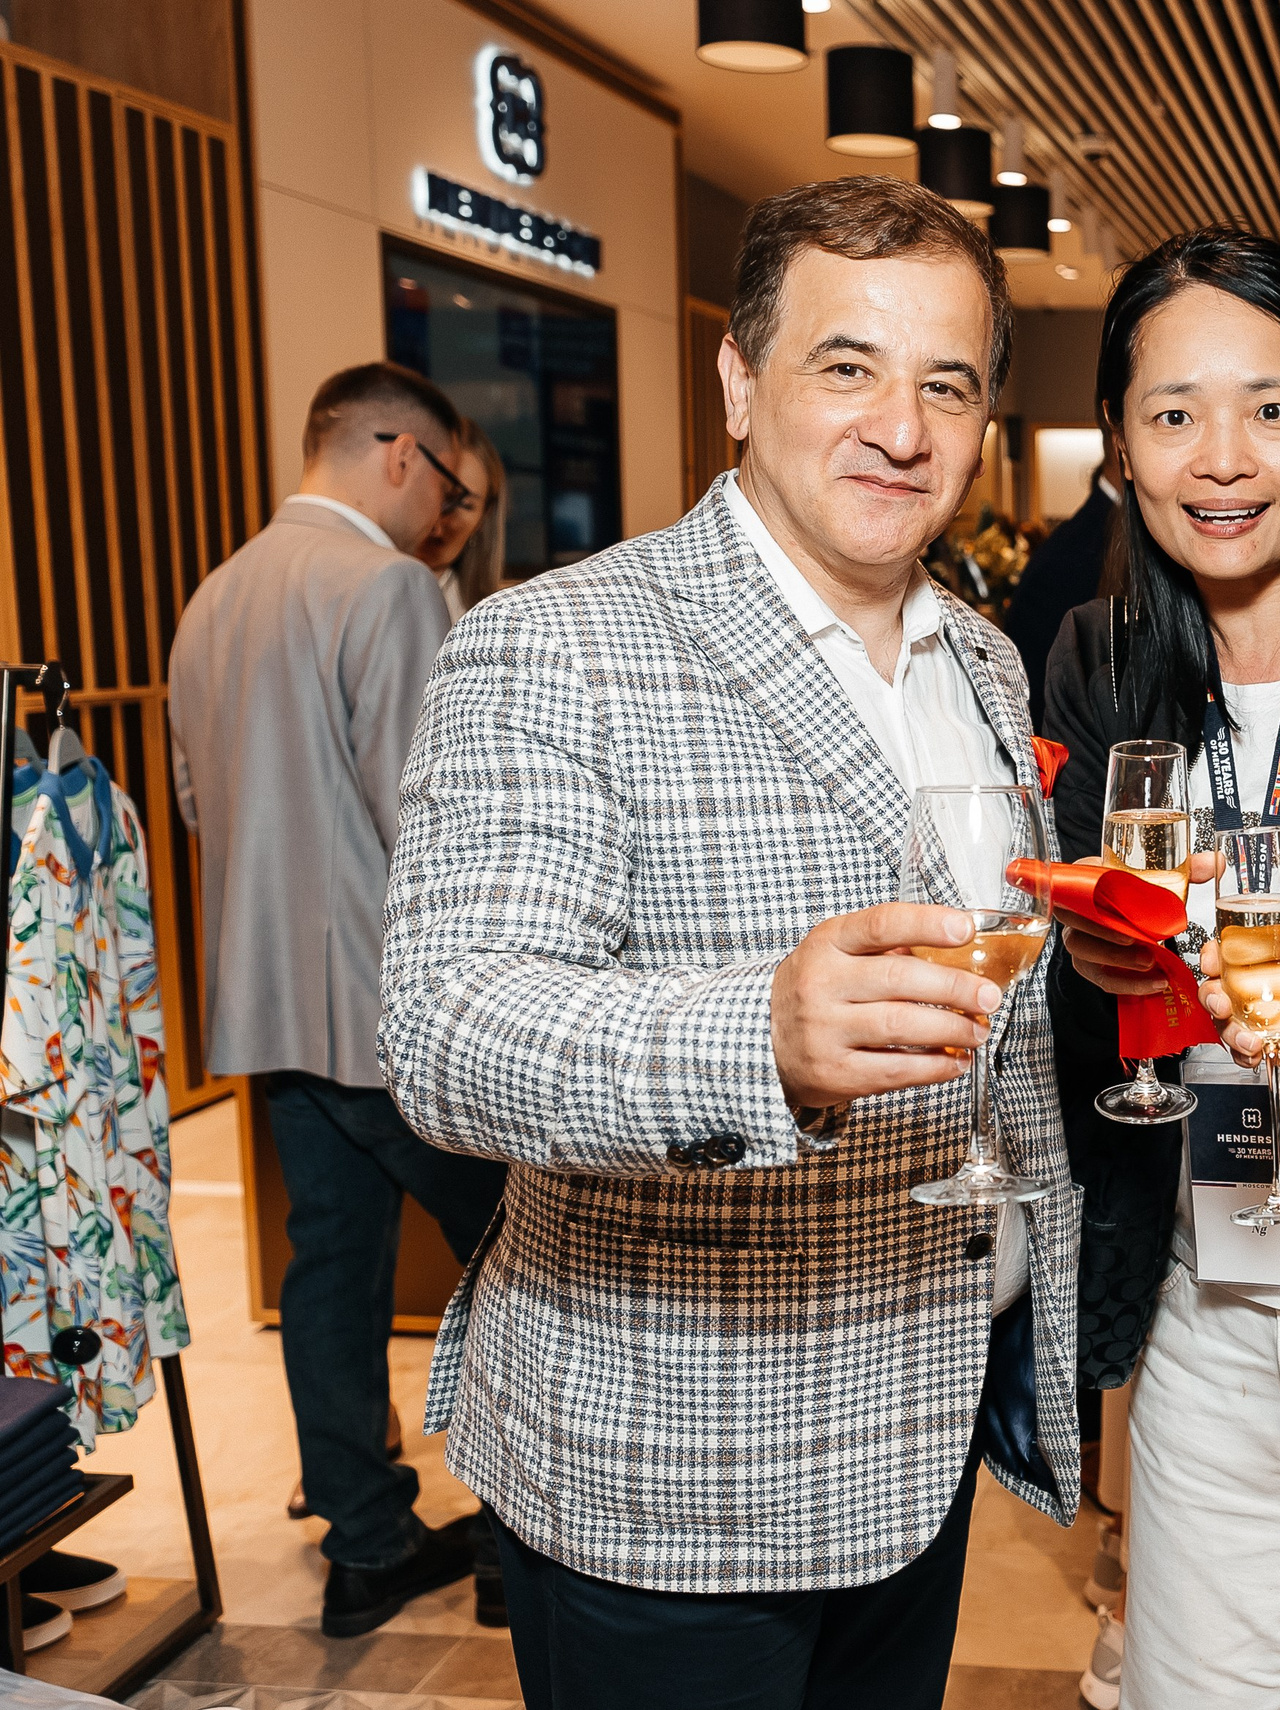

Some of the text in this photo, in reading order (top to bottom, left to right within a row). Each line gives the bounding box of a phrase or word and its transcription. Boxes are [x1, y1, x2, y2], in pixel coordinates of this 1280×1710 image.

[1210, 739, 1218, 750] OF
[1215, 776, 1225, 800] STYLE
[1218, 740, 1235, 796] 30 YEARS
[1163, 985, 1179, 1027] HEND
[1247, 1148, 1272, 1156] YEARS
